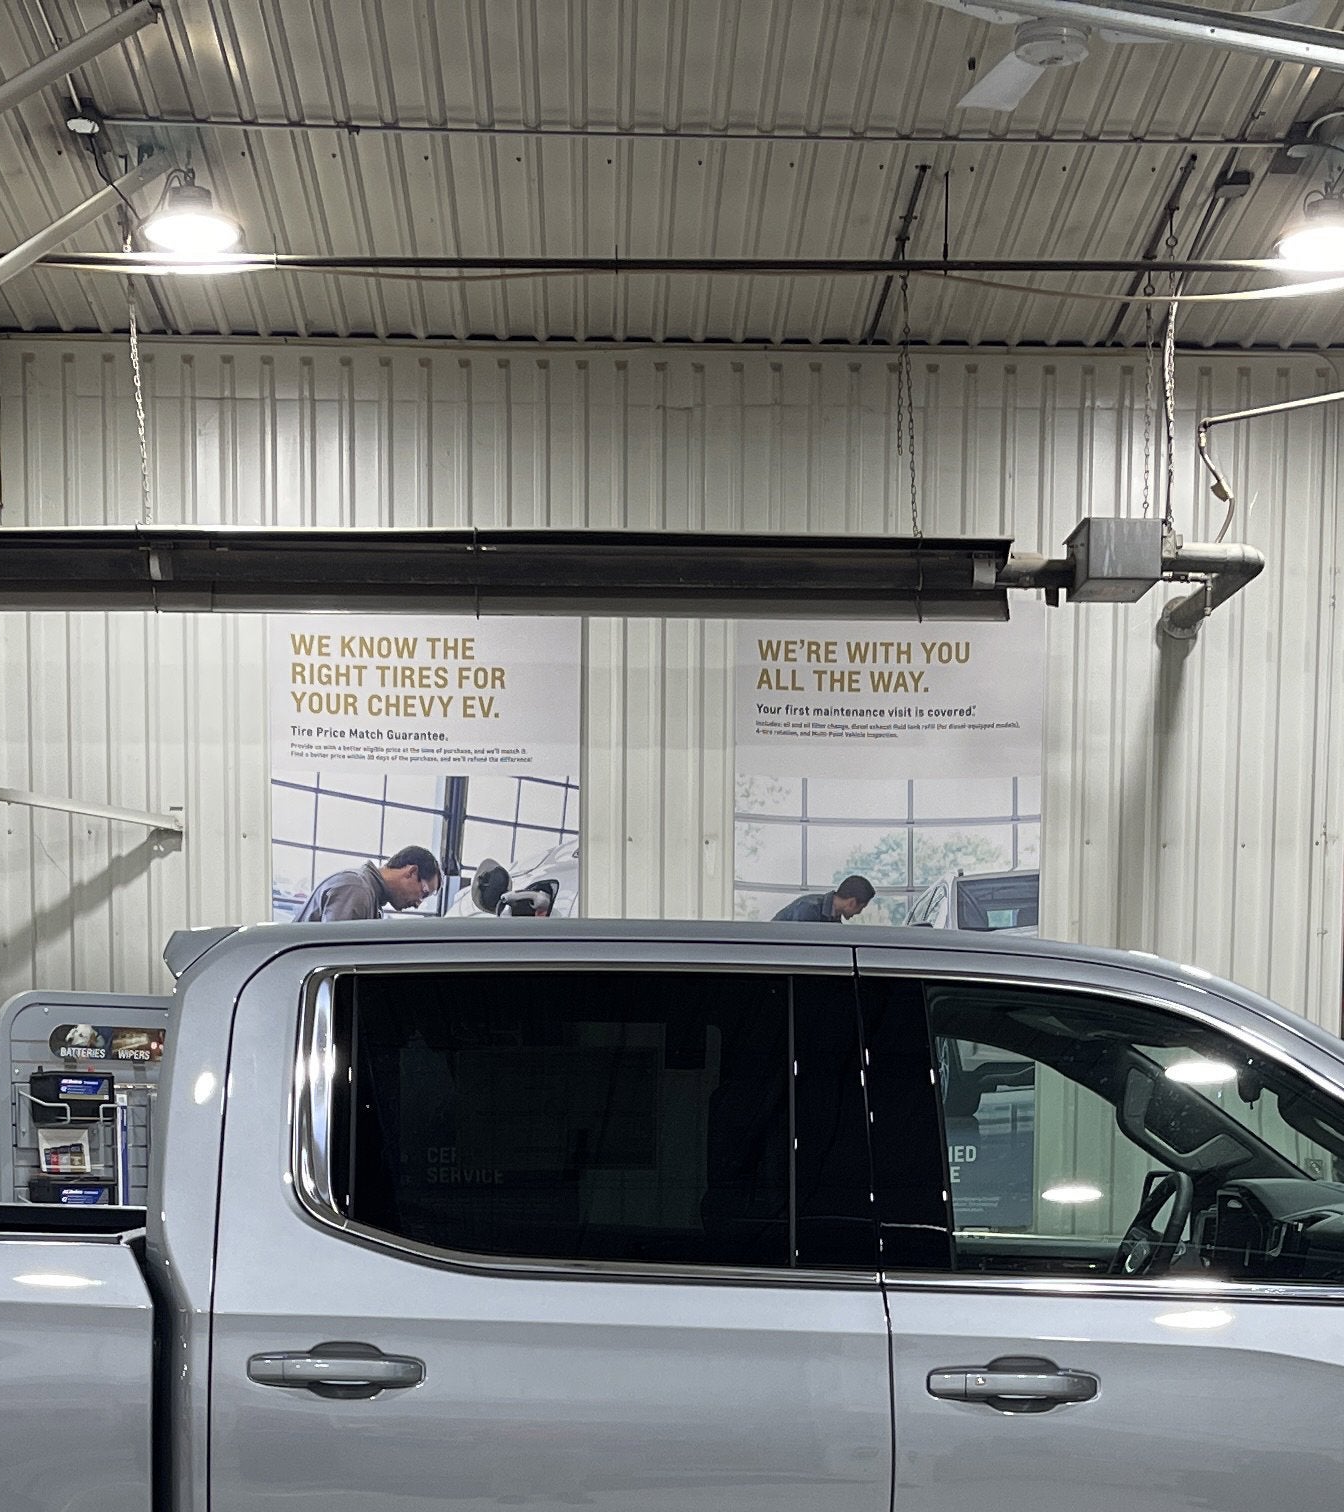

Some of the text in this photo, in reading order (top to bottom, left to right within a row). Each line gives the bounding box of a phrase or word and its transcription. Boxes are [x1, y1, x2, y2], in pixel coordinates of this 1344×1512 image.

[290, 633, 475, 660] WE KNOW THE
[757, 639, 971, 664] WE'RE WITH YOU
[290, 662, 506, 690] RIGHT TIRES FOR
[756, 668, 930, 693] ALL THE WAY.
[290, 691, 500, 719] YOUR CHEVY EV.
[756, 703, 782, 716] Your
[785, 704, 810, 716] first
[812, 705, 885, 717] maintenance
[888, 706, 912, 717] visit
[915, 706, 924, 717] is
[290, 725, 449, 742] Tire Price Match Guarantee.
[60, 1047, 106, 1059] BATTERIES
[118, 1049, 150, 1060] WIPERS
